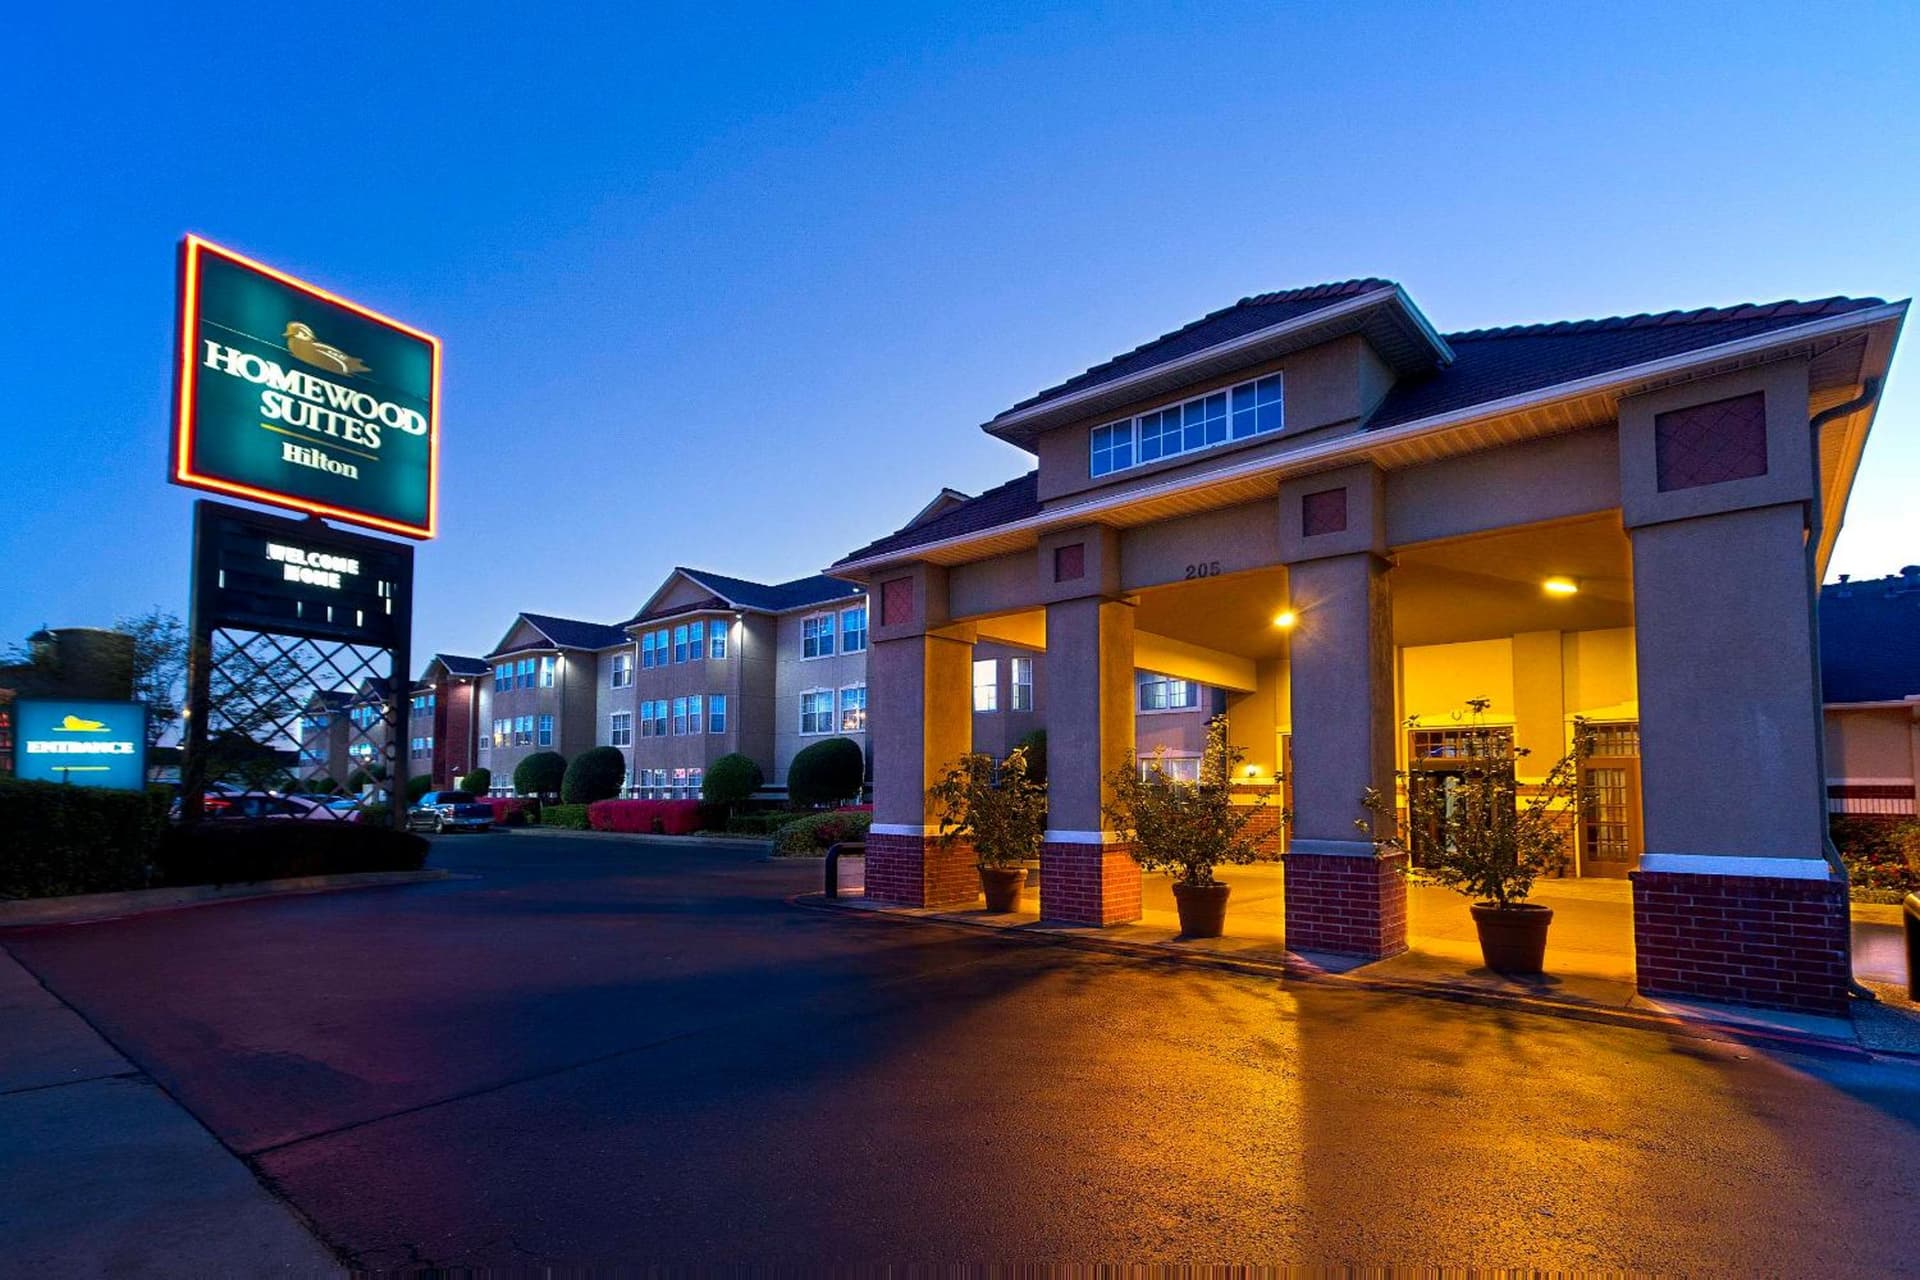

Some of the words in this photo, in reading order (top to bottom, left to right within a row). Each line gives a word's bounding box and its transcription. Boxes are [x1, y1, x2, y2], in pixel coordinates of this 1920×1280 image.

[204, 339, 426, 435] HOMEWOOD
[260, 390, 381, 448] SUITES
[281, 442, 358, 479] Hilton
[266, 543, 359, 575] WELCOME
[1185, 561, 1221, 580] 205
[26, 741, 135, 754] ENTRANCE
